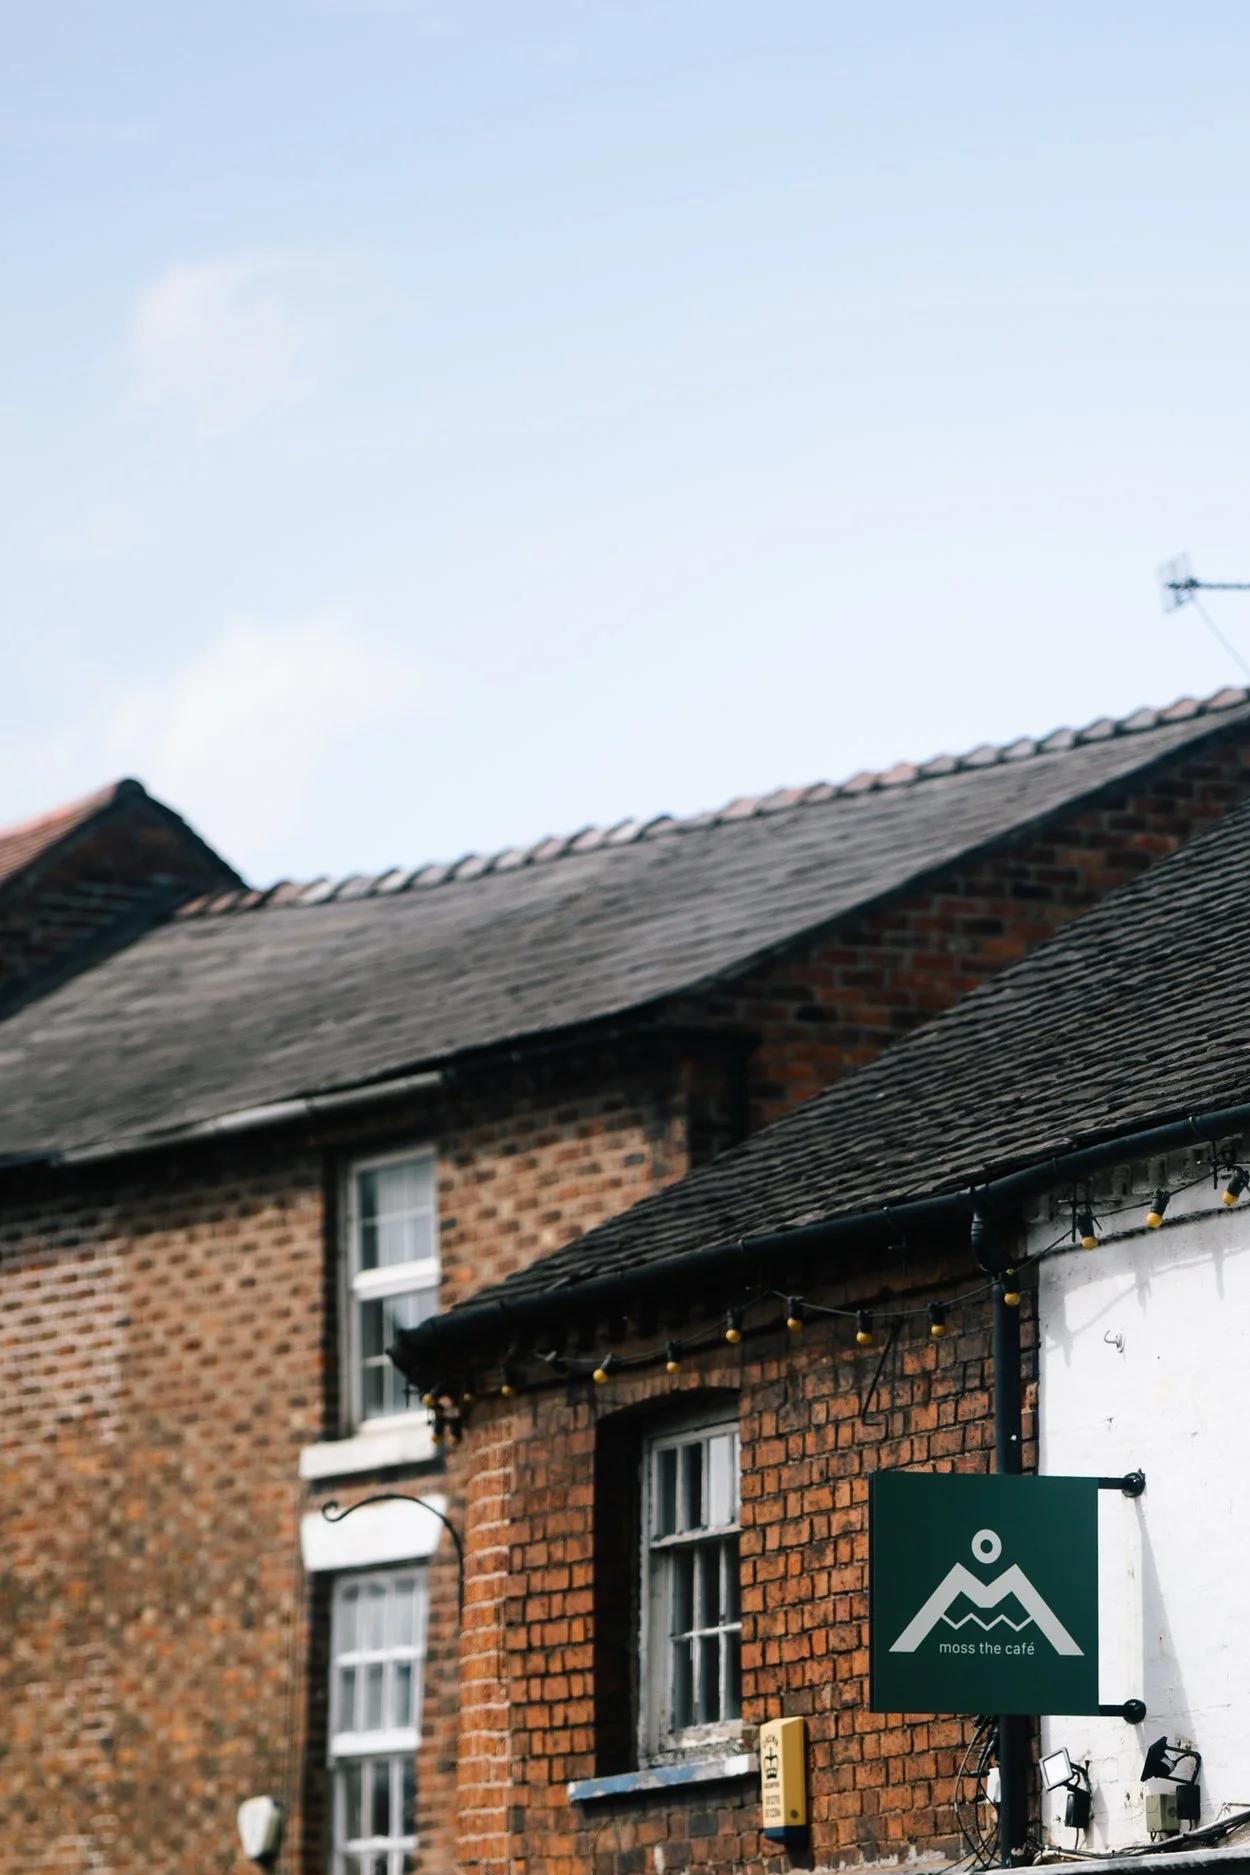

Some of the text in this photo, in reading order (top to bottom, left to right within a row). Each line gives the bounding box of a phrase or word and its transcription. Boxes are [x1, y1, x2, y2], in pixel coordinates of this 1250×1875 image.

[939, 1641, 1035, 1656] moss the café
